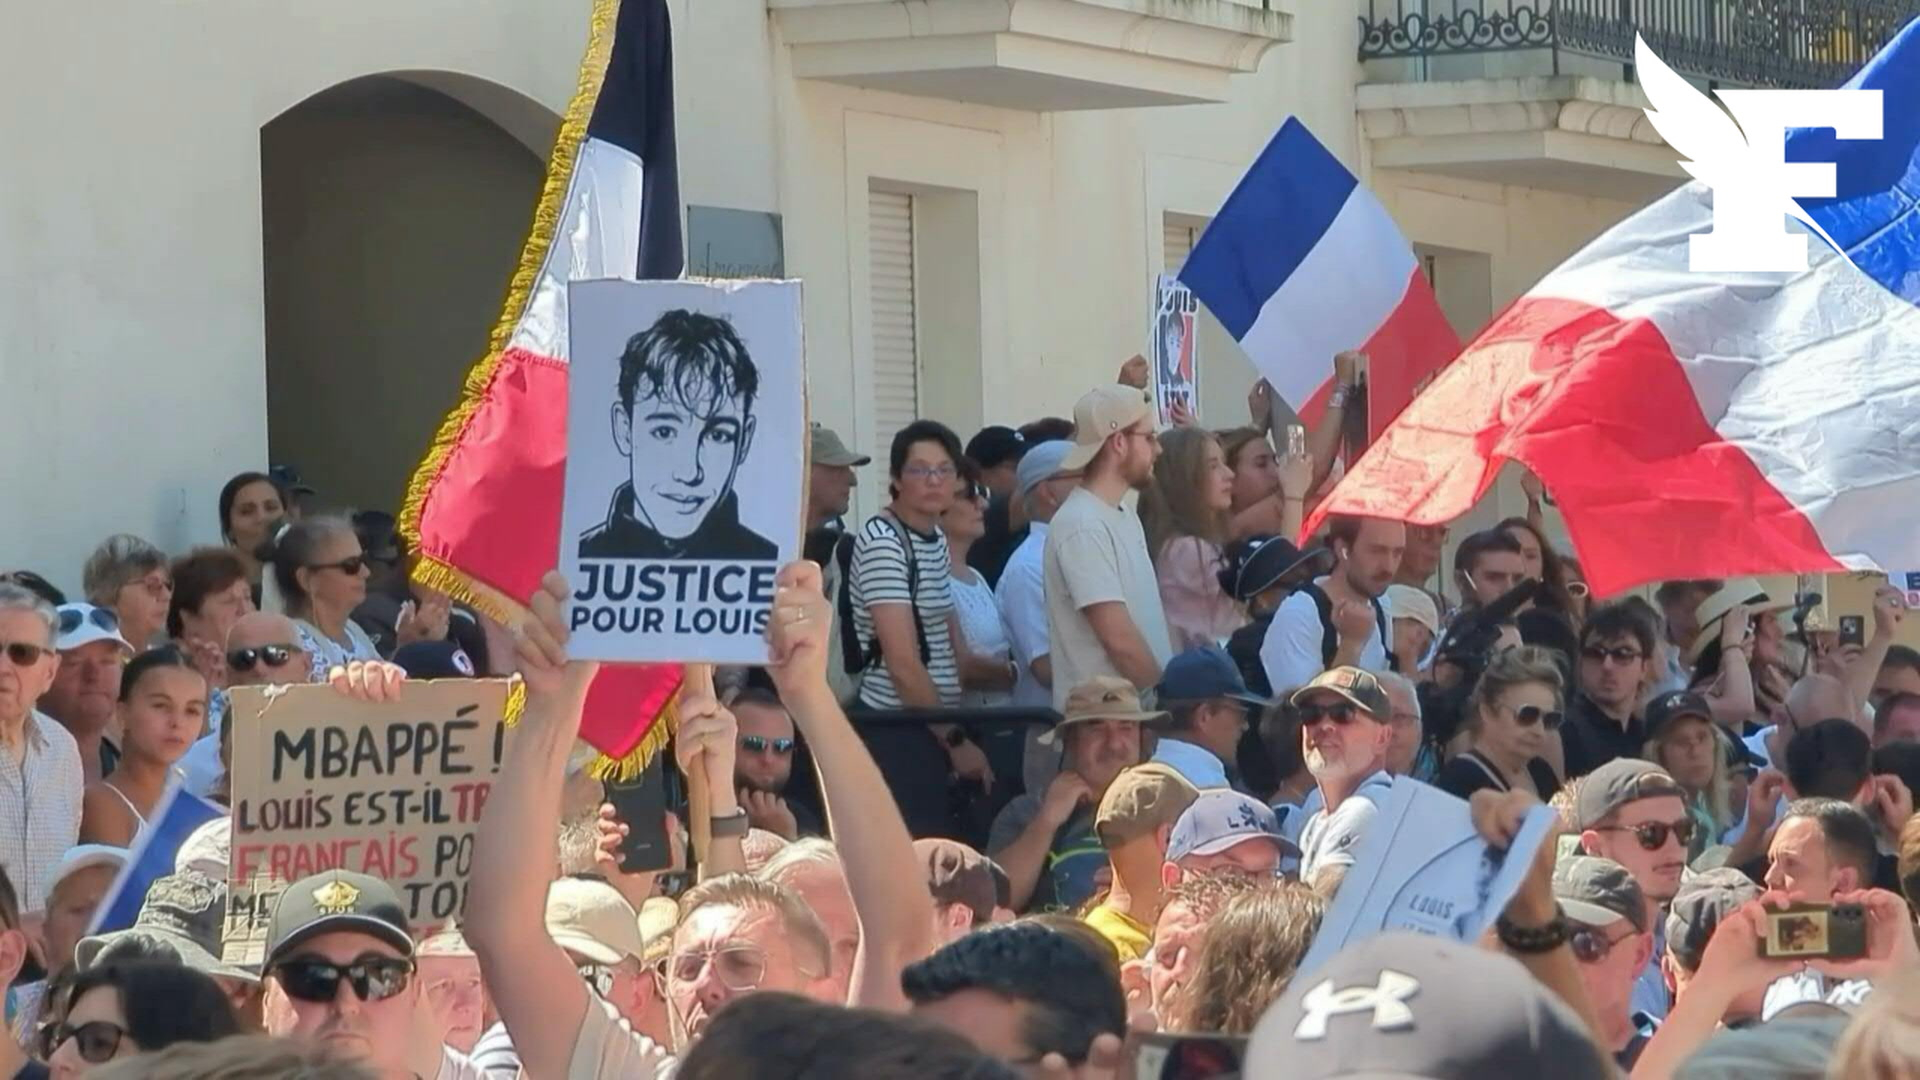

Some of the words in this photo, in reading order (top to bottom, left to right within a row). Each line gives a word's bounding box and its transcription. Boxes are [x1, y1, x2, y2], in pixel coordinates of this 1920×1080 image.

[573, 564, 777, 604] JUSTICE
[571, 606, 665, 634] POUR
[674, 608, 773, 635] LOUIS
[272, 703, 480, 783] MBAPPÉ
[1409, 893, 1455, 920] LOUIS
